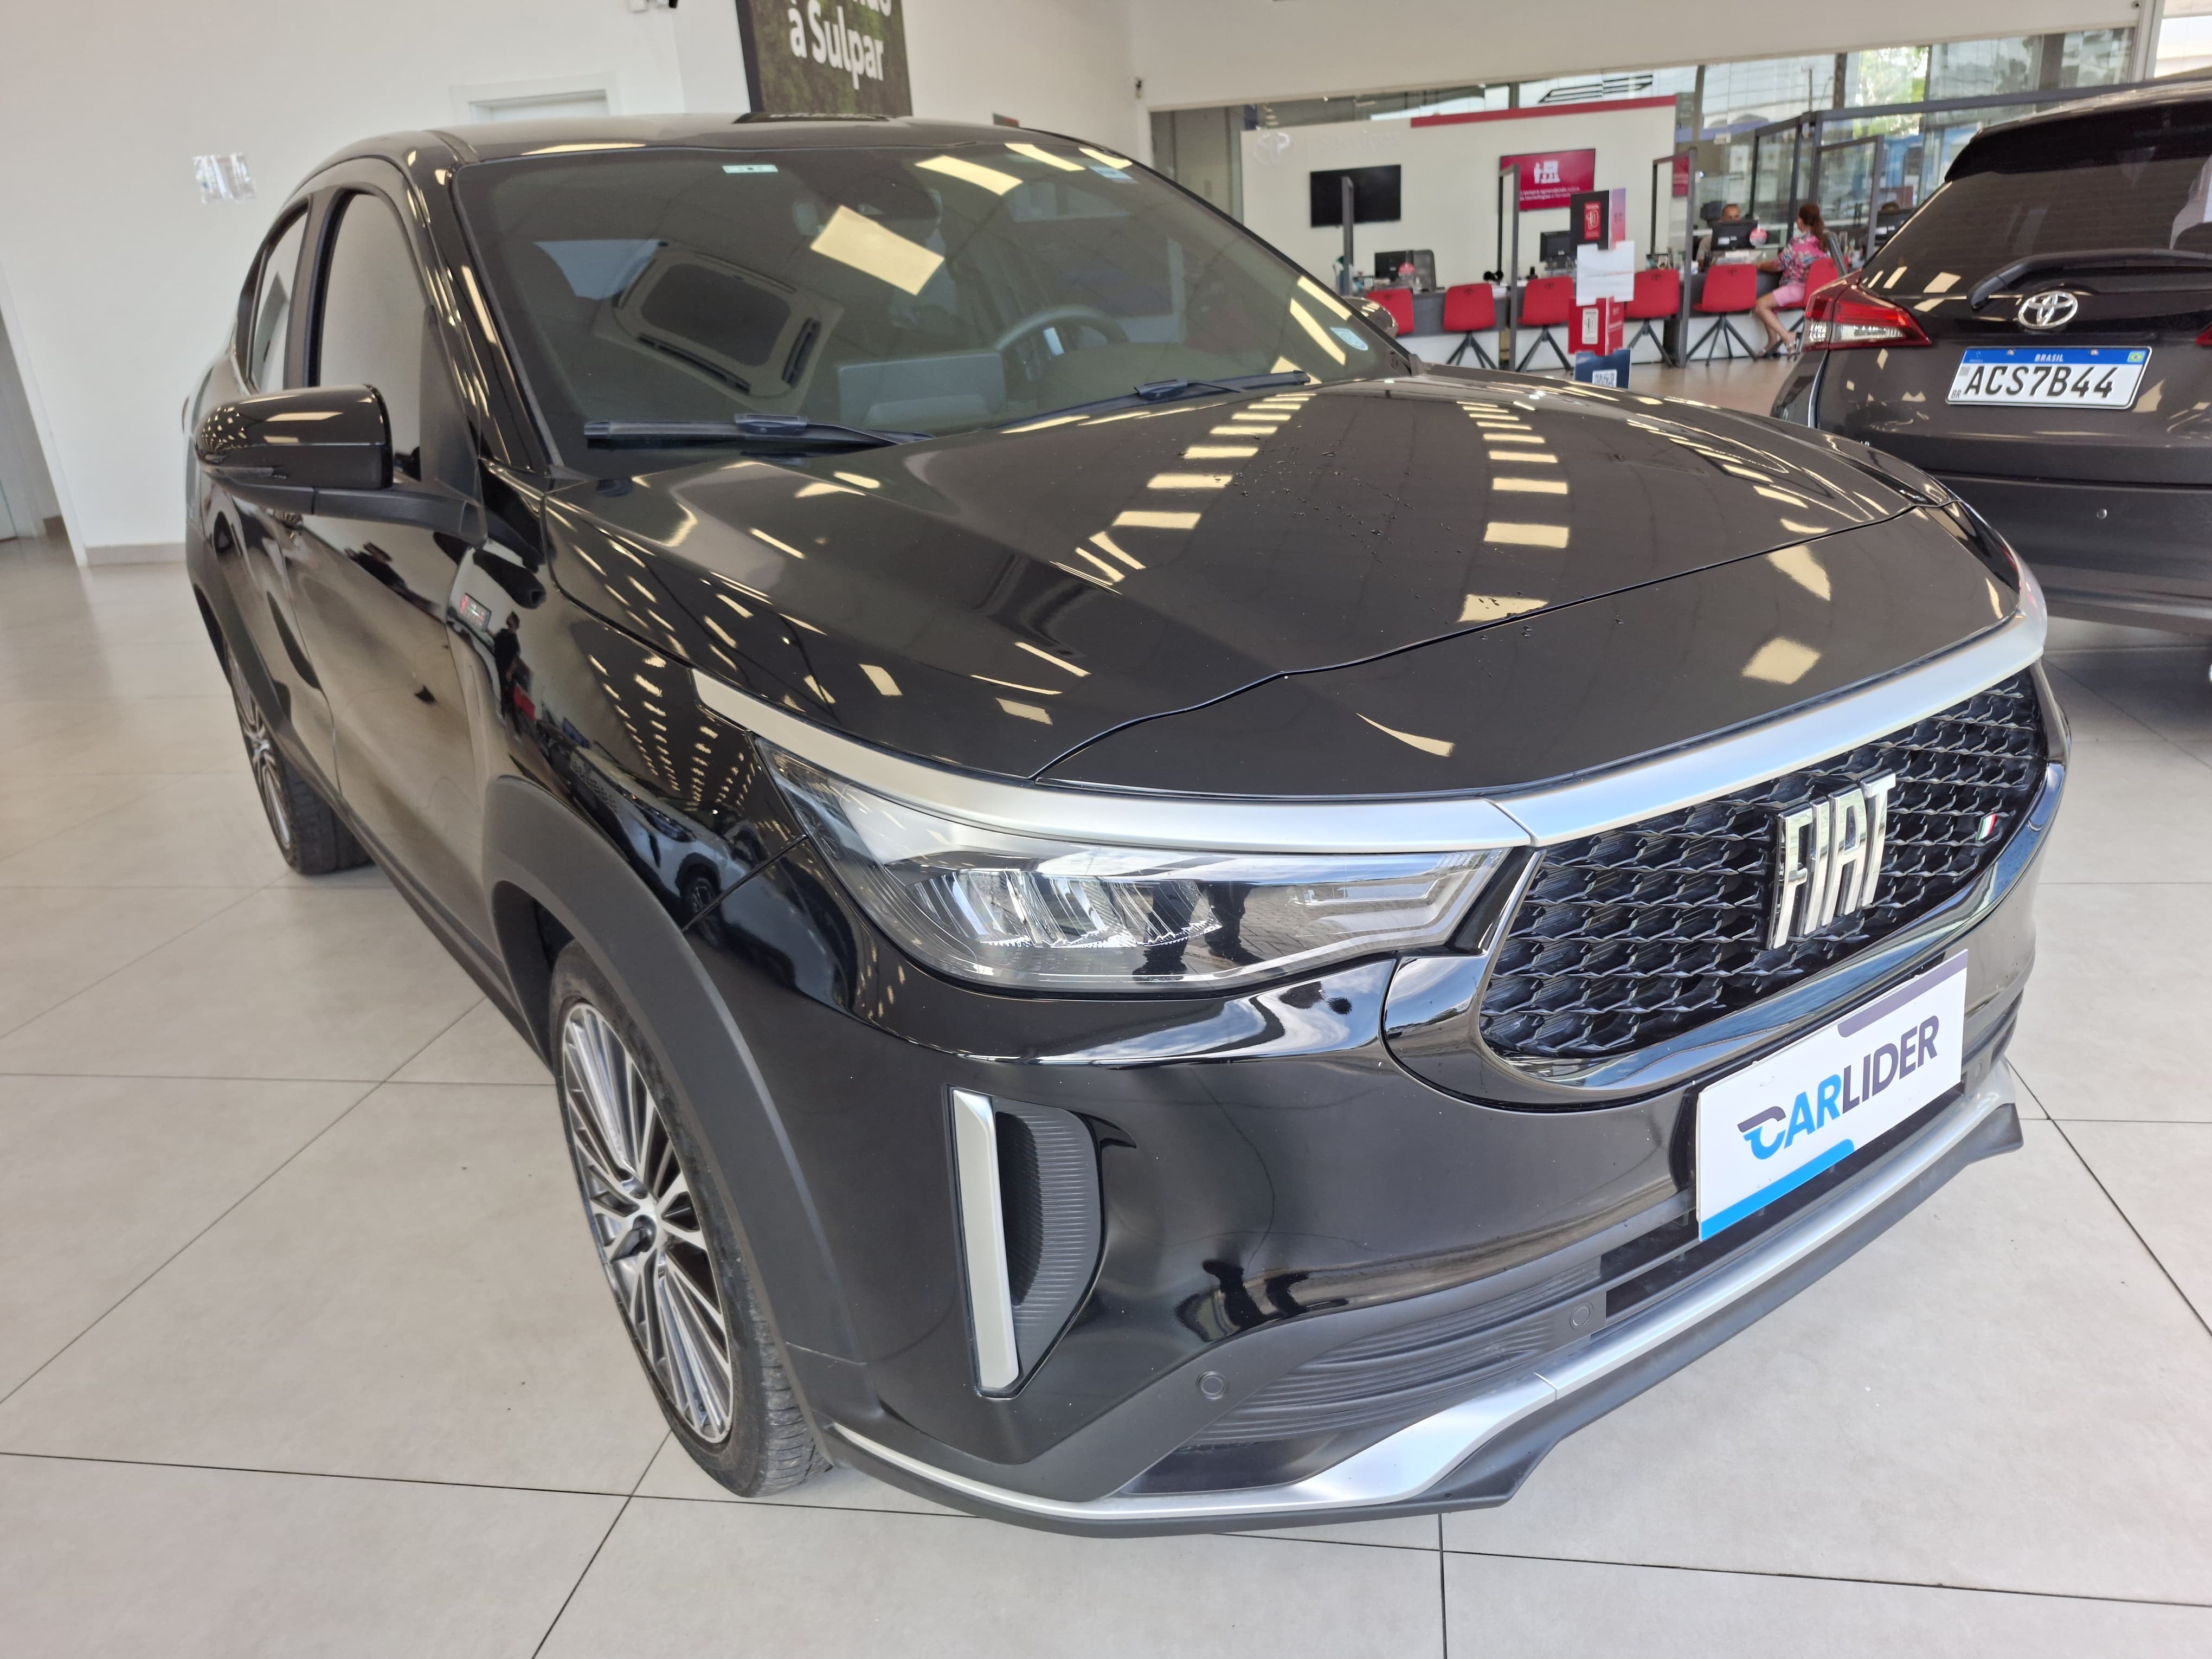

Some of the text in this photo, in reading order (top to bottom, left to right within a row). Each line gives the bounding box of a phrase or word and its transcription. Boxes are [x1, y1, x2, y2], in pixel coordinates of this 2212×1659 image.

[788, 0, 884, 90] à Sulpar
[1964, 366, 2118, 398] ACS7B44
[2034, 353, 2063, 362] BRASIL
[1951, 389, 1960, 398] BR
[1768, 769, 1896, 950] FIAT
[1737, 1015, 1939, 1160] CARLIDER
